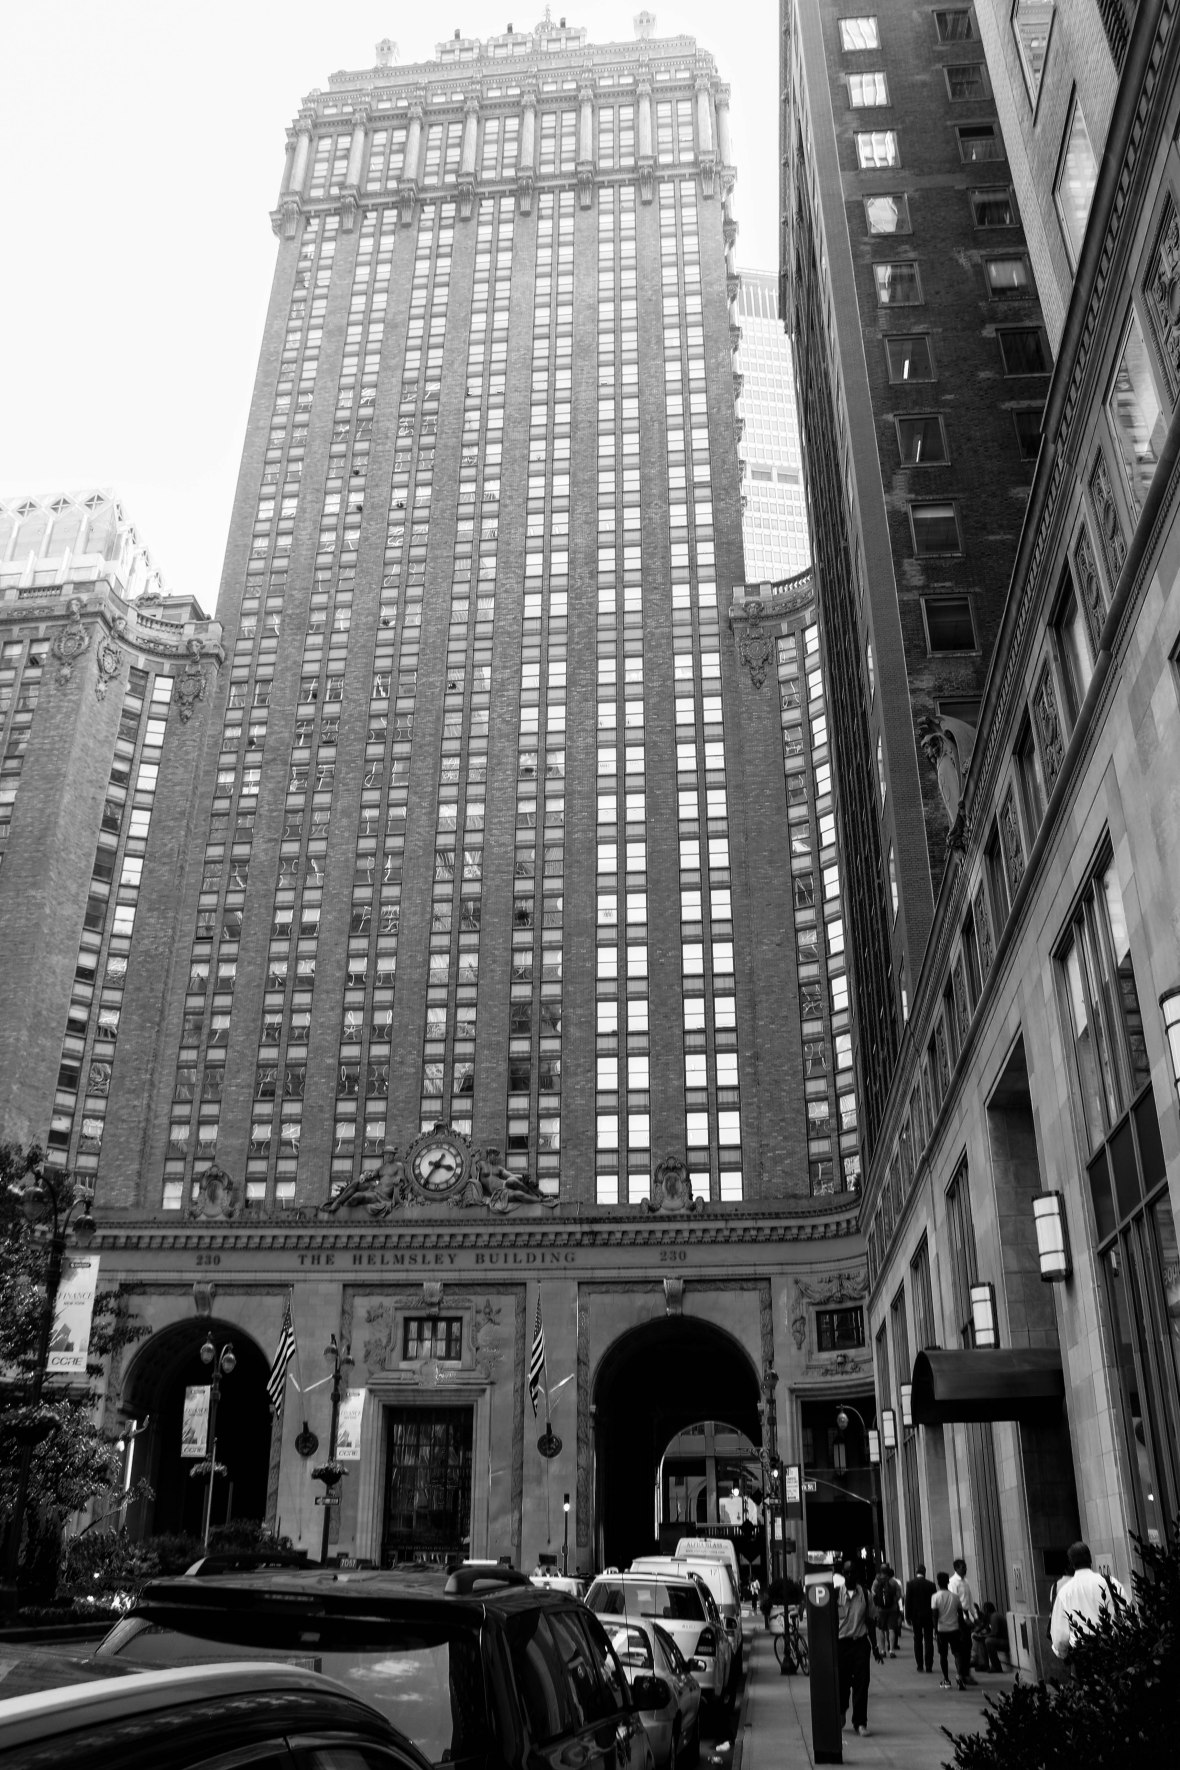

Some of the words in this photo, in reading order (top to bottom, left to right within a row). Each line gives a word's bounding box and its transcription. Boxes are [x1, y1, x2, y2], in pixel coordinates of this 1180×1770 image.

[195, 1253, 221, 1266] 230
[297, 1253, 335, 1266] THE
[352, 1252, 458, 1266] HELMSLEY
[474, 1251, 575, 1265] BUILDING
[659, 1249, 687, 1262] 230
[815, 1586, 826, 1604] P
